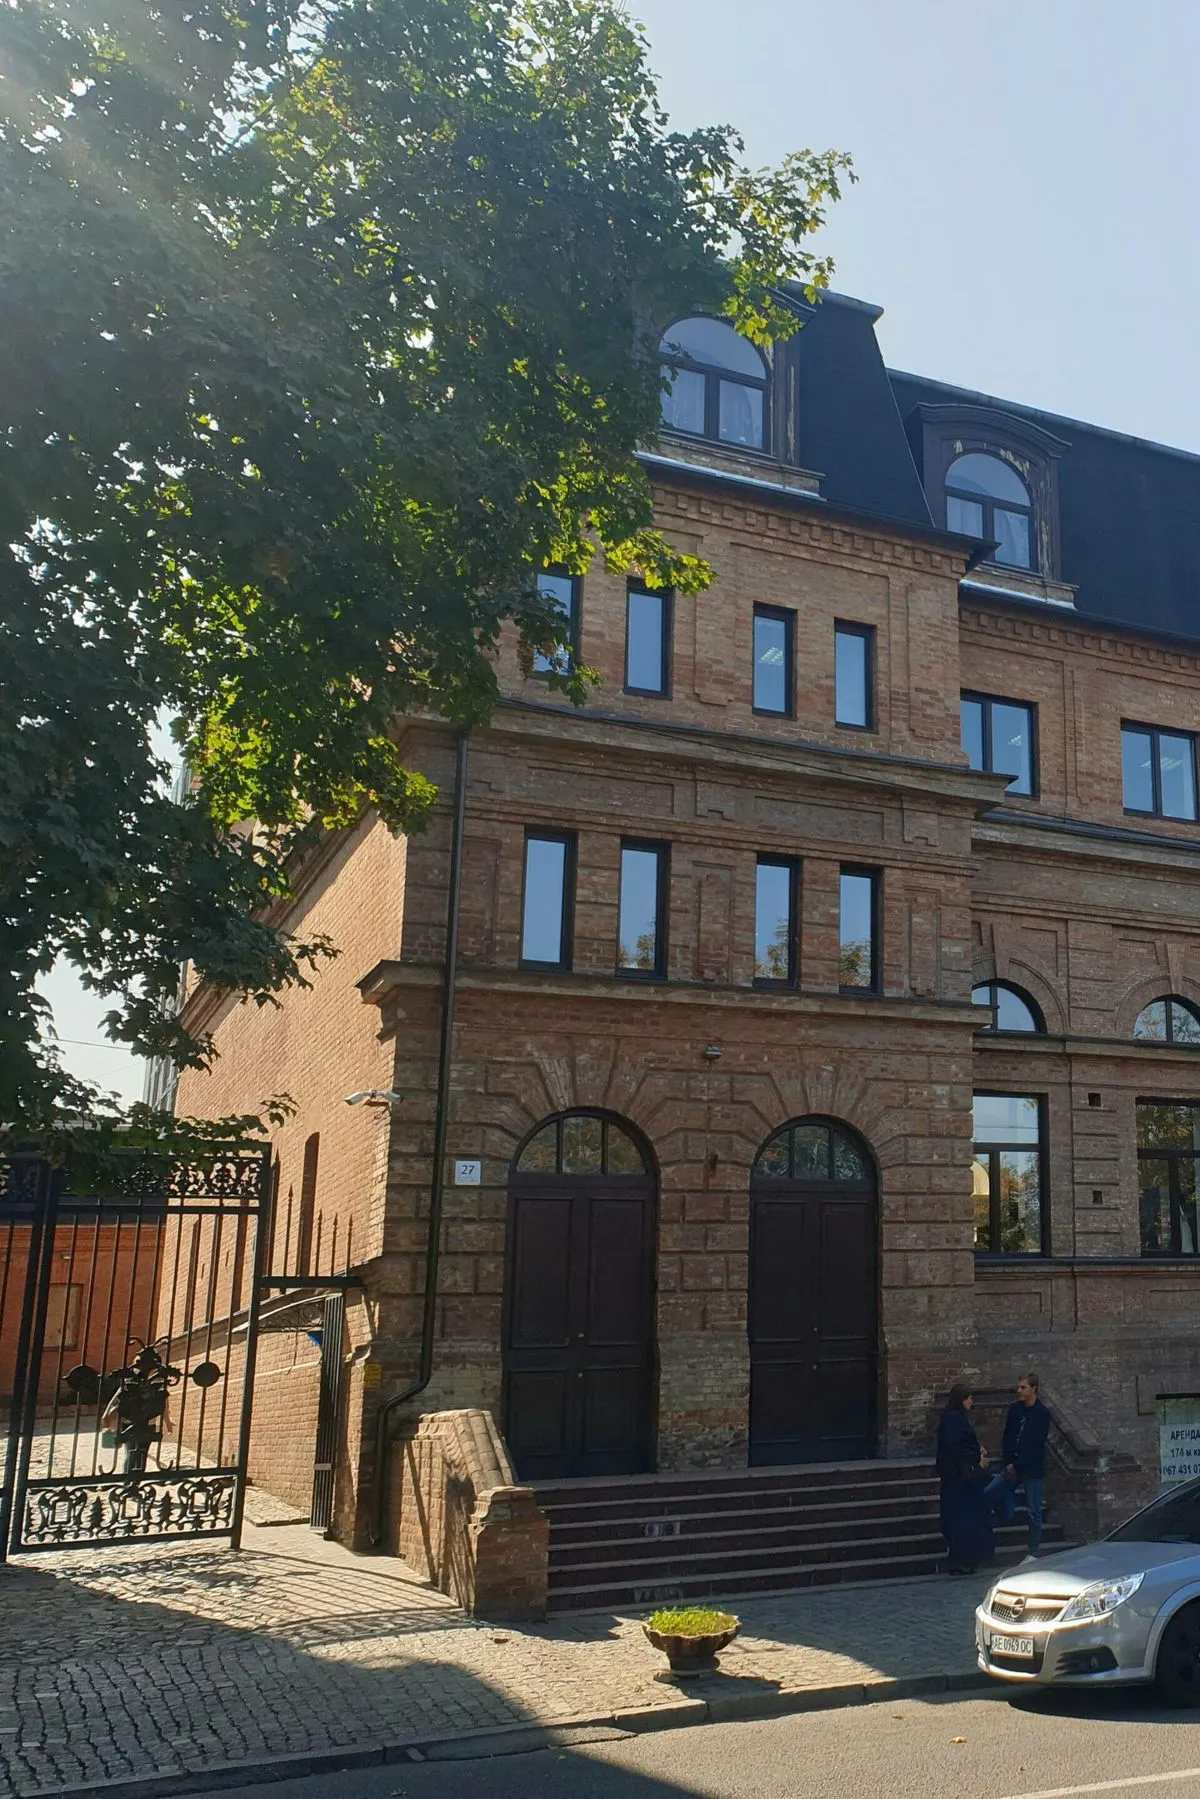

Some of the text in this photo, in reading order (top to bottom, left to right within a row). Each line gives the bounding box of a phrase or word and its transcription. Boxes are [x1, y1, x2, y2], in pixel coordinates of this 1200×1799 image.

[461, 1164, 475, 1175] 27
[1170, 1429, 1200, 1440] АРЕНДА
[1163, 1465, 1176, 1476] 067
[1178, 1464, 1192, 1475] 431
[994, 1636, 1003, 1650] AE
[1020, 1640, 1032, 1653] OC
